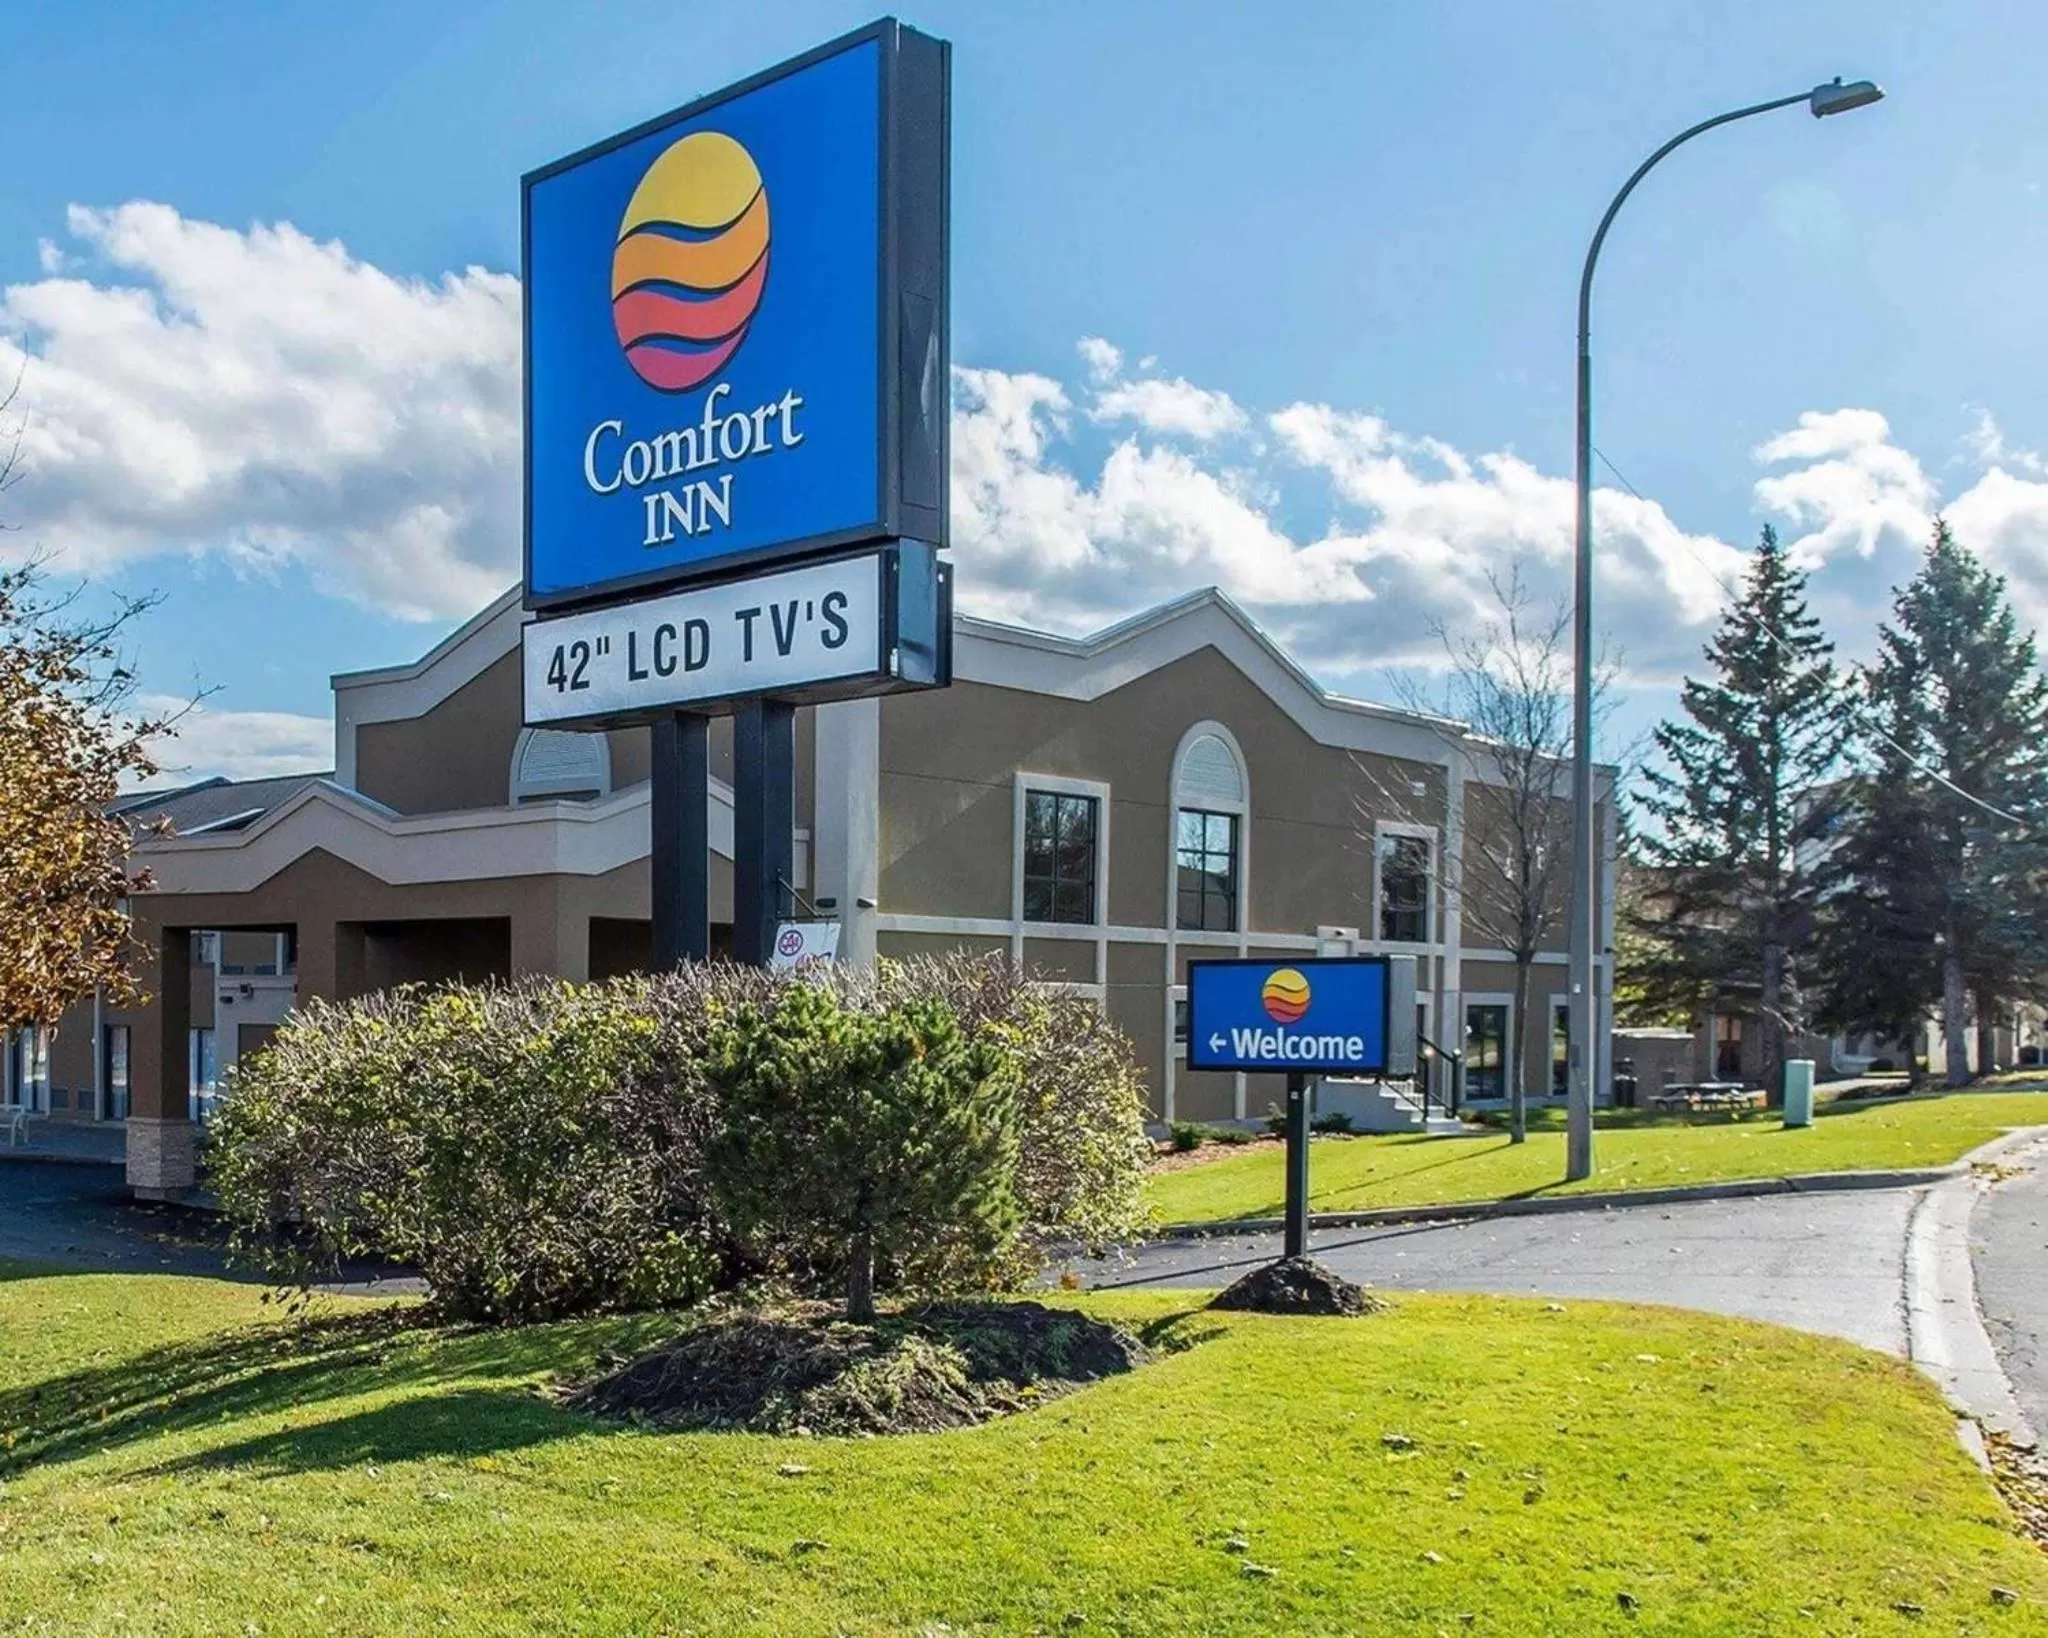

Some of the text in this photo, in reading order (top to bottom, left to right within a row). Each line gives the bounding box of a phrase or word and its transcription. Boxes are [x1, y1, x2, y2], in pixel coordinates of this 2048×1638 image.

[583, 382, 803, 495] Comfort
[643, 474, 733, 546] INN
[547, 591, 849, 693] 42" LCD TV'S
[1231, 1027, 1364, 1060] Welcome
